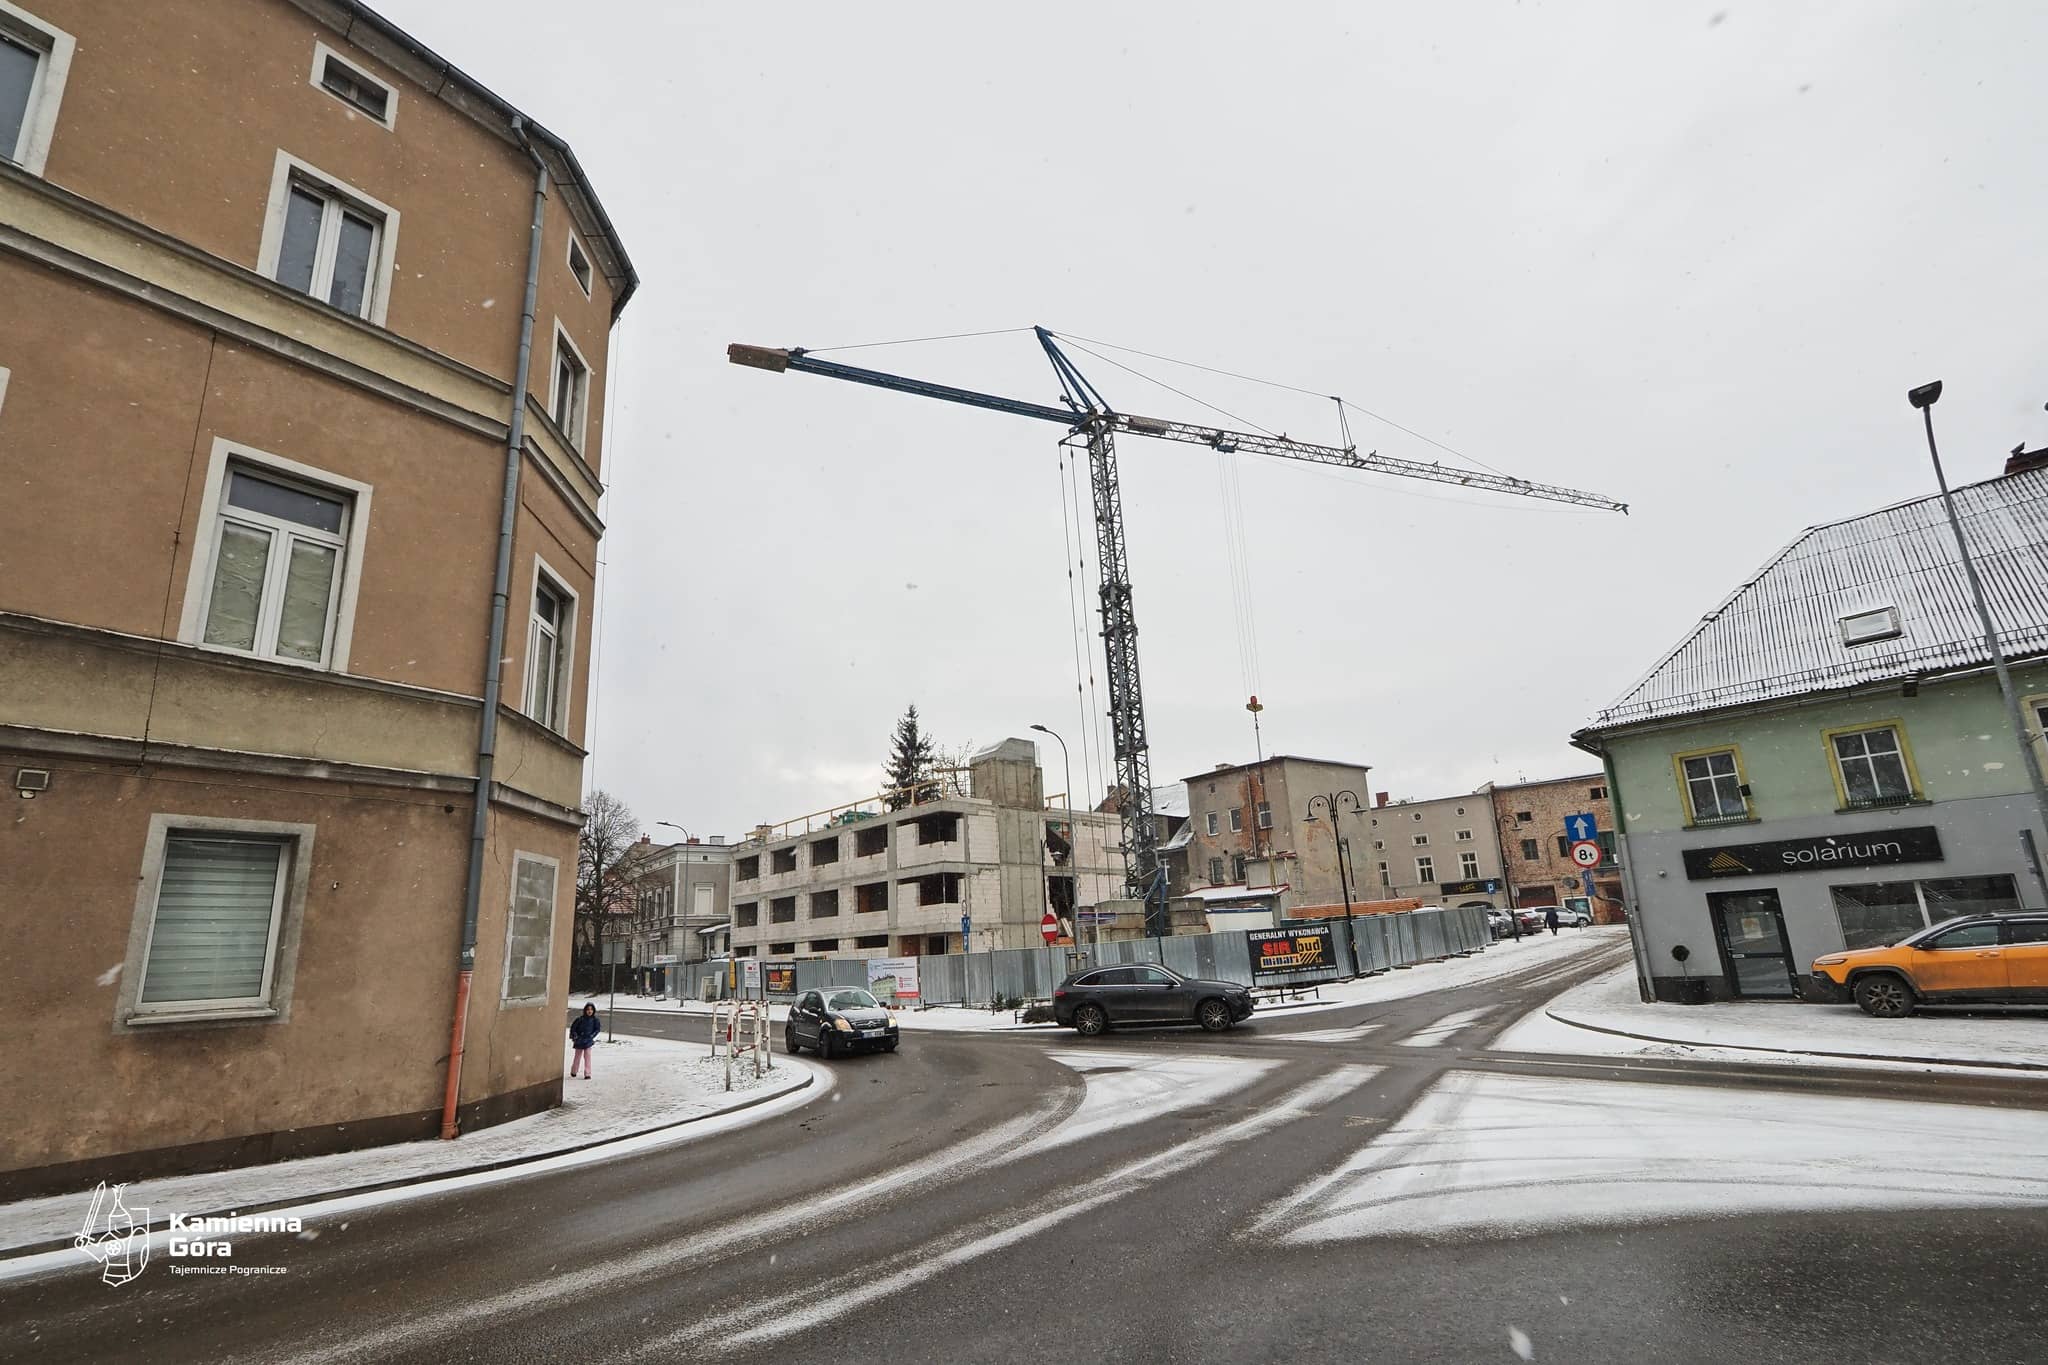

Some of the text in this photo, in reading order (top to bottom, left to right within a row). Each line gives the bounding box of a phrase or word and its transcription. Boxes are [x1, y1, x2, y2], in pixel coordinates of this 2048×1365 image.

[1782, 842, 1902, 864] solarium
[1488, 883, 1494, 893] P
[1249, 926, 1329, 940] GENERALNY WYKONAWCA
[1262, 940, 1320, 955] SIR bud
